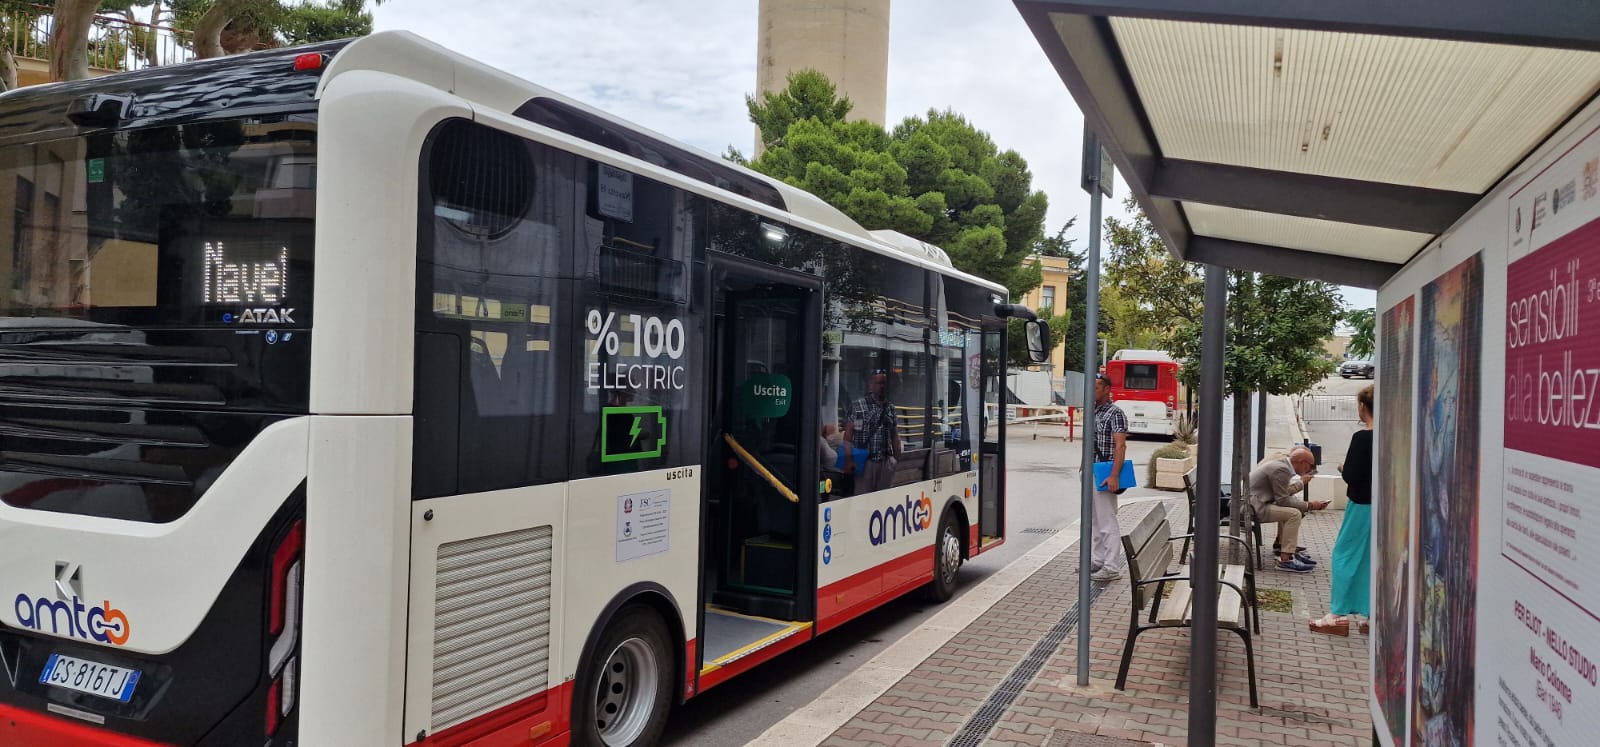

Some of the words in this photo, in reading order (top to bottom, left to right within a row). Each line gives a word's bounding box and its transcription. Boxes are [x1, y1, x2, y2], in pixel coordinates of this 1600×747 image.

[222, 308, 296, 325] e-ATAK
[1510, 258, 1580, 348] sensibili
[587, 309, 620, 356] %
[630, 313, 685, 360] 100
[587, 362, 685, 391] ELECTRIC
[753, 384, 788, 397] Uscita
[1508, 355, 1533, 423] alla
[1538, 350, 1600, 429] bellez
[666, 467, 694, 481] uscita
[869, 491, 933, 546] amtab
[15, 593, 130, 645] amtab
[1546, 627, 1567, 661] NELLO
[1568, 643, 1597, 688] STUDIO
